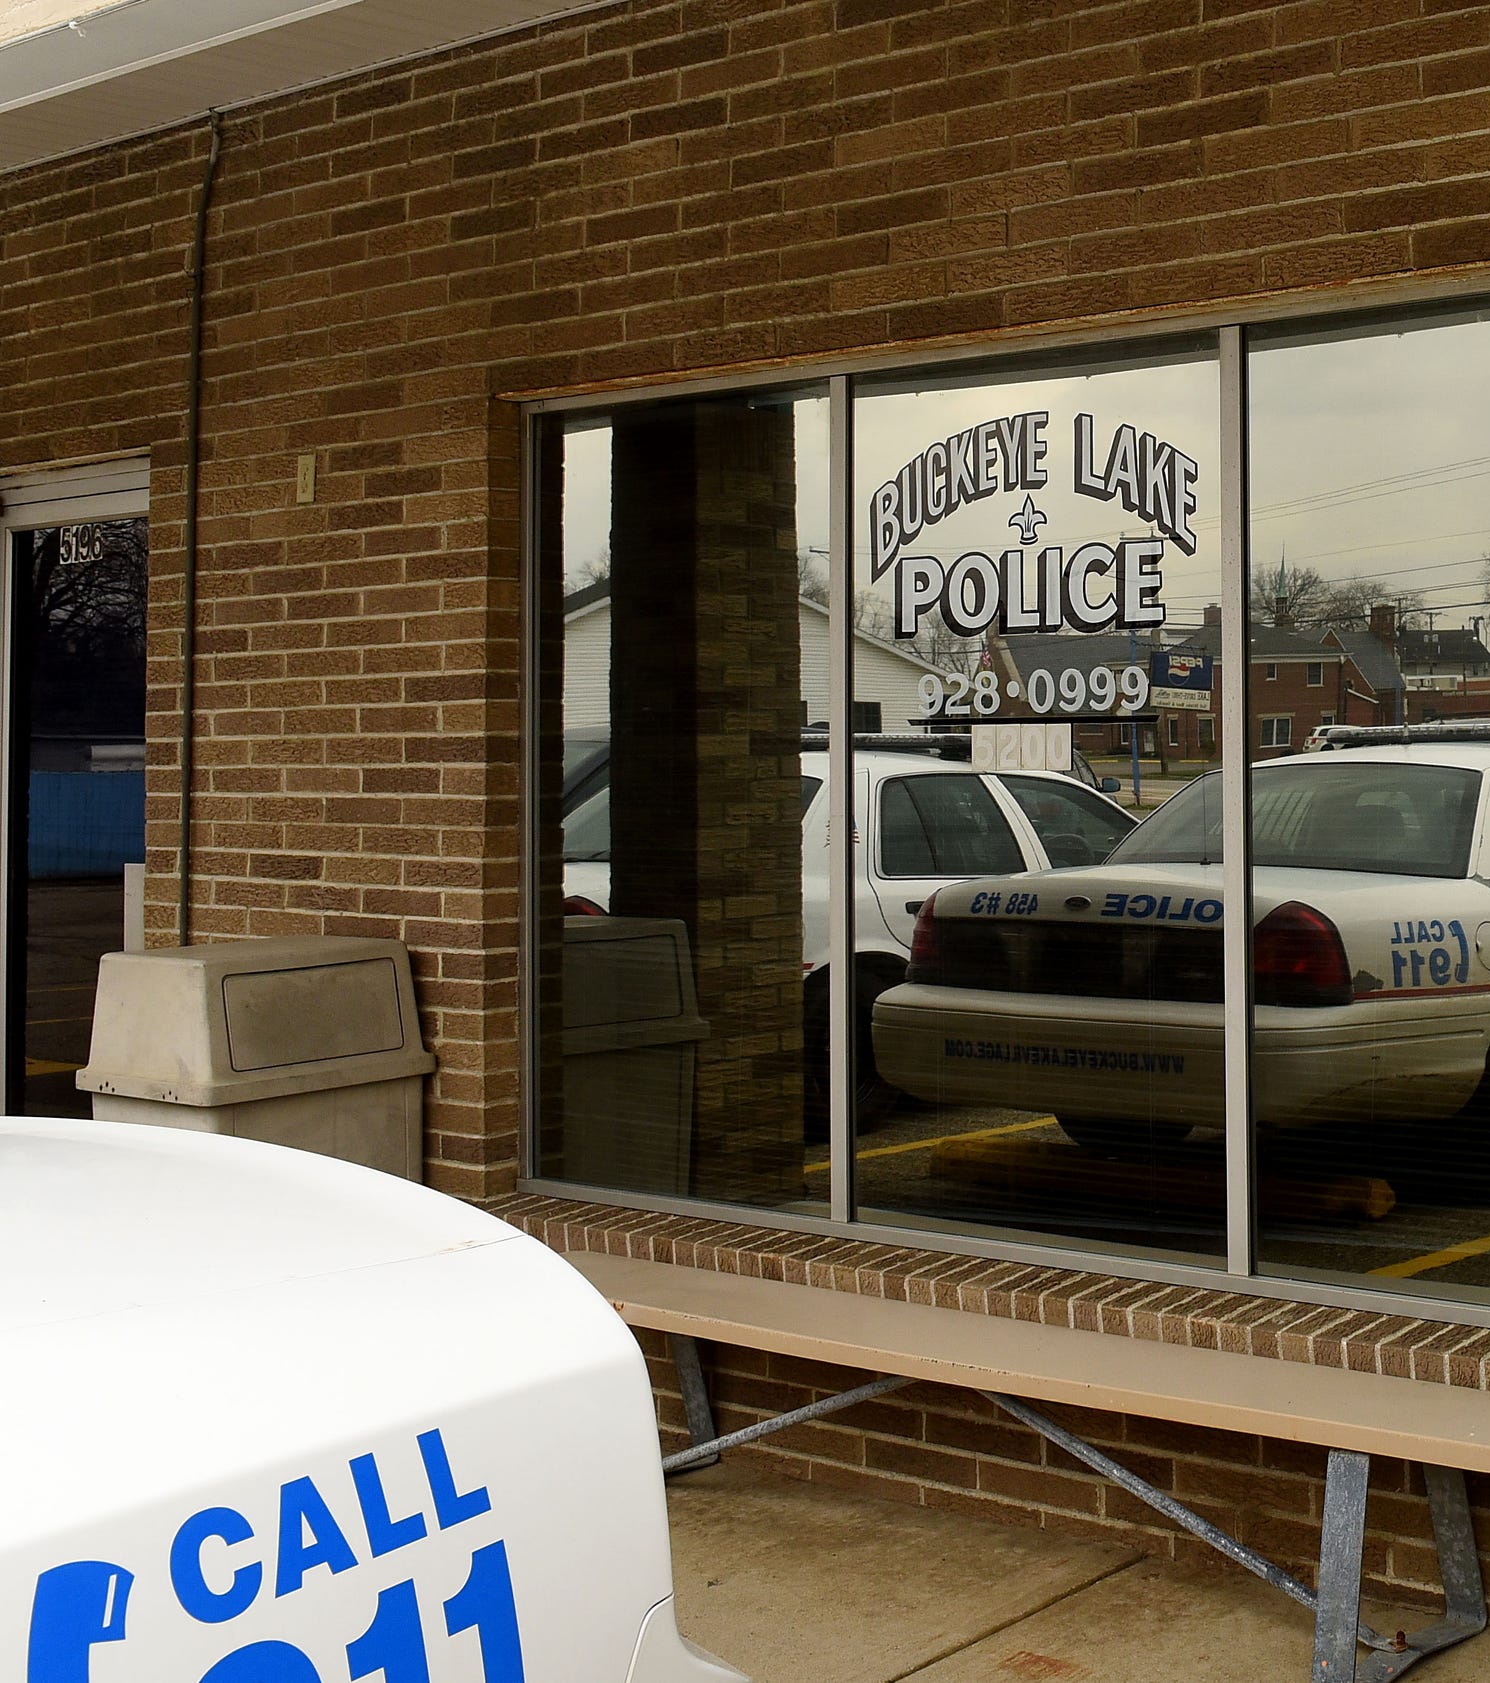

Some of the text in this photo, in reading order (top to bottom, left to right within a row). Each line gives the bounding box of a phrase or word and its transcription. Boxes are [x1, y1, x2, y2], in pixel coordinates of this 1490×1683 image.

[60, 524, 103, 564] 5196
[869, 411, 1199, 585] BUCKEYE LAKE
[894, 539, 1166, 640] POLICE
[973, 726, 1069, 769] 5200
[167, 1427, 493, 1625] CALL
[195, 1538, 526, 1683] 11
